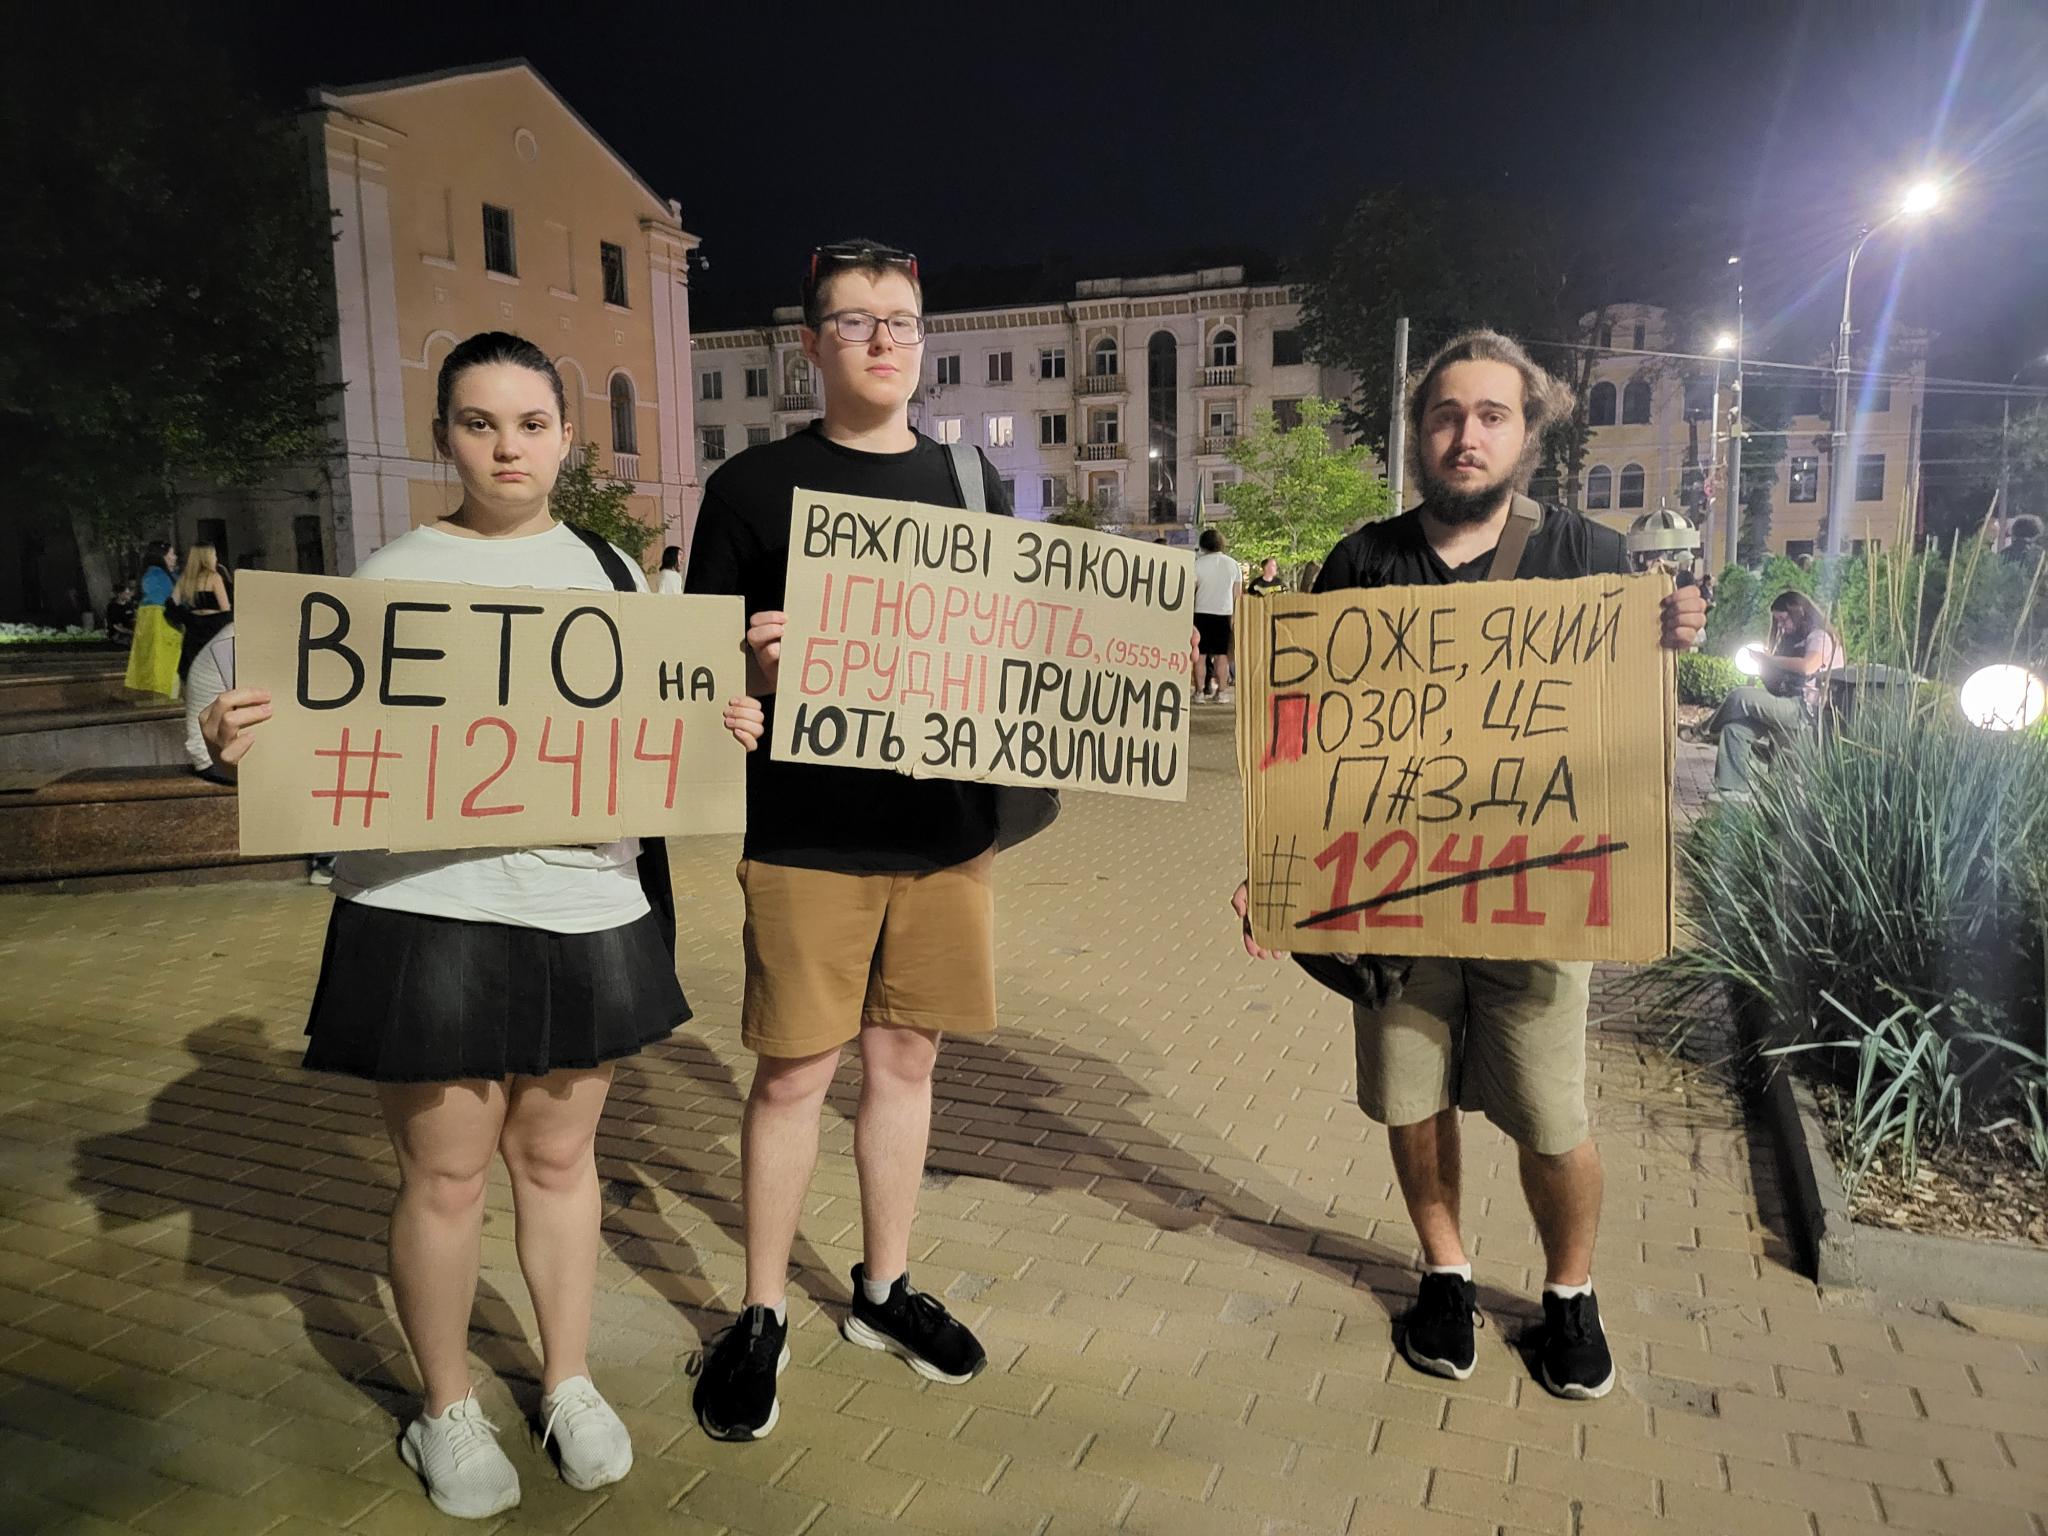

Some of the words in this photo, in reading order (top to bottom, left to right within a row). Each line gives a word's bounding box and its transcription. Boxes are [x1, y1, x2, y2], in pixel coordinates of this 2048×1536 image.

[803, 504, 991, 577] ВАЖЛИВІ
[1013, 532, 1186, 611] ЗАКОНИ
[297, 591, 623, 710] ВЕТО
[820, 573, 1101, 664] ІГНОРУЮТЬ,
[1269, 606, 1469, 687] БОЖЕ,
[1480, 588, 1624, 676] ЯКИЙ
[799, 637, 988, 714] БРУДНІ
[1266, 683, 1453, 758] ПОЗОР,
[1482, 679, 1573, 741] ЦЕ
[311, 716, 684, 828] #12414
[791, 703, 905, 762] ЮТЬ
[921, 712, 977, 769] ЗА
[989, 717, 1178, 787] ХВИЛИНИ
[1323, 754, 1579, 831] П#ЗДА
